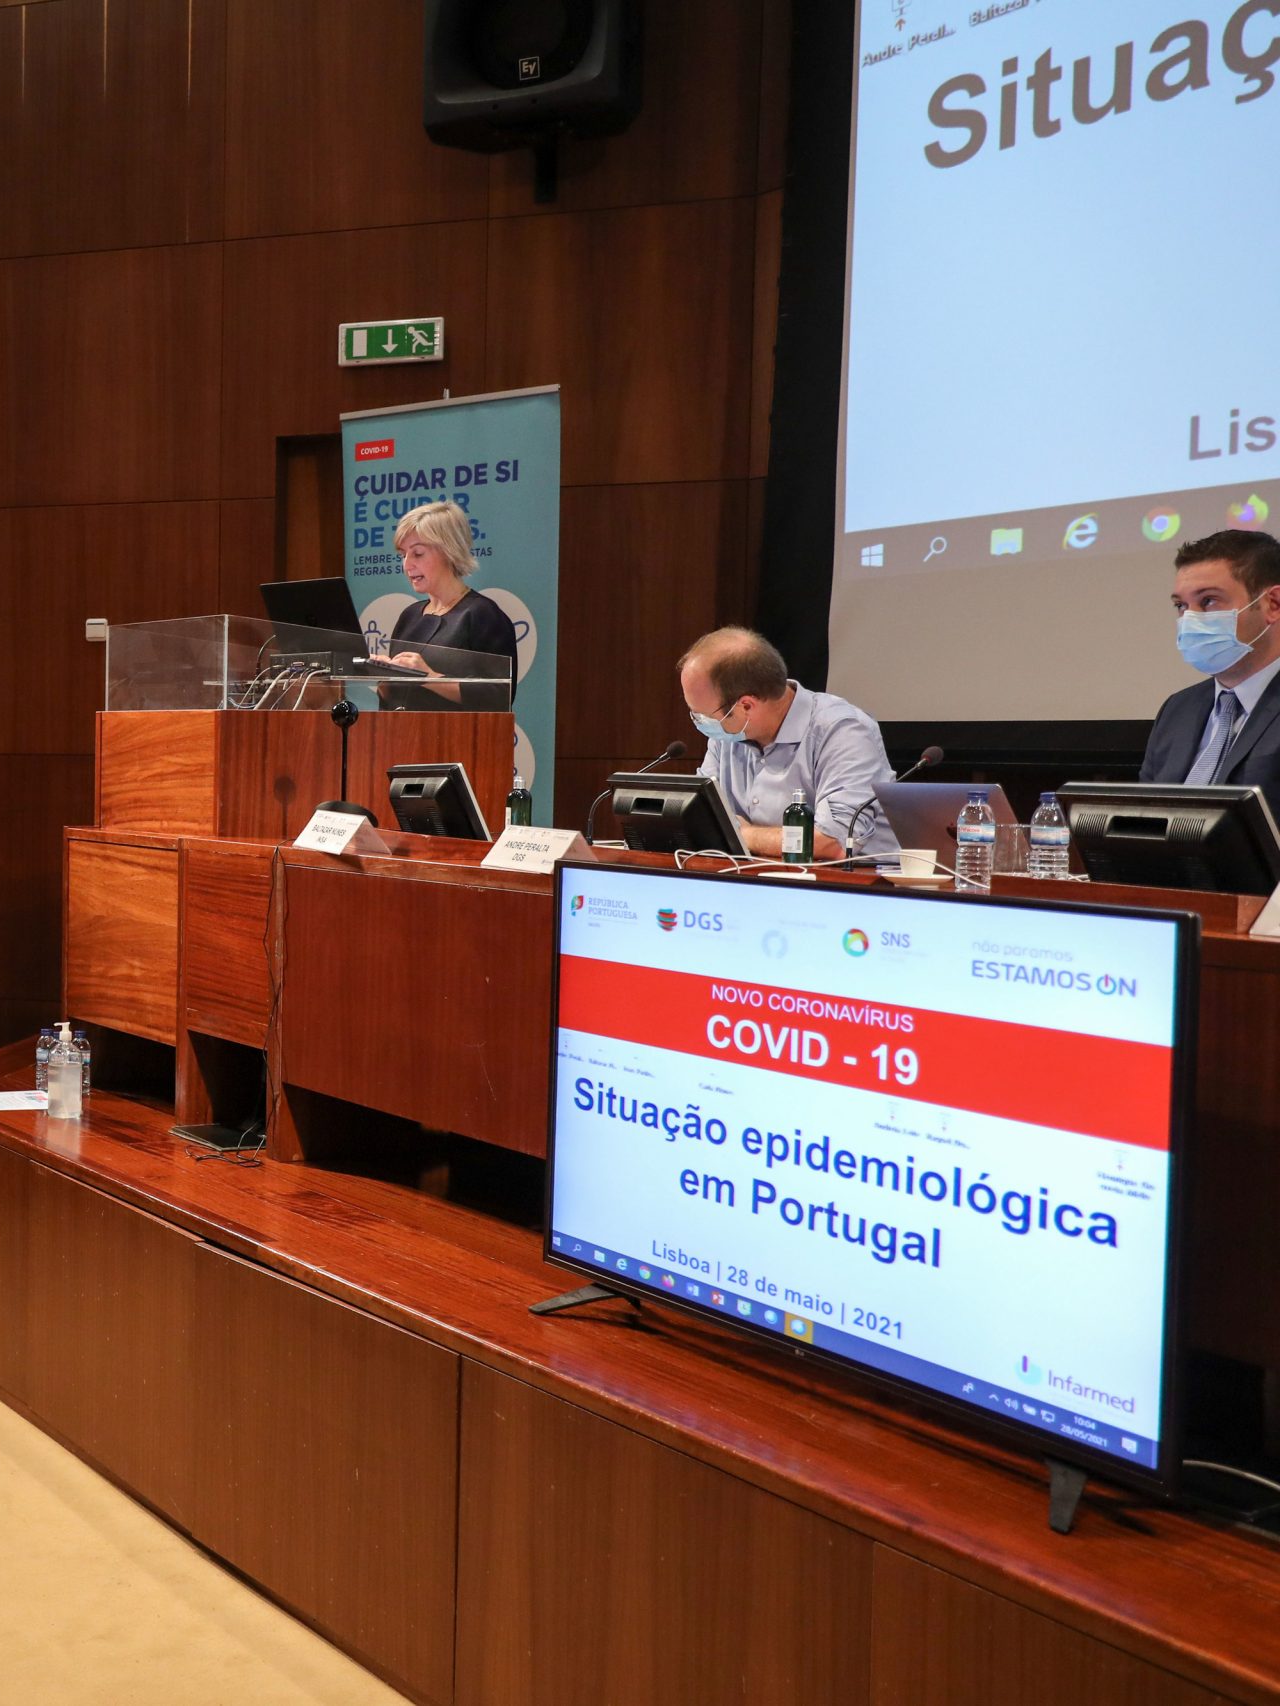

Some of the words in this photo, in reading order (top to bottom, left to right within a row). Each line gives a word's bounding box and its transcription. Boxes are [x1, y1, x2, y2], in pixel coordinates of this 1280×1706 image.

[1189, 409, 1277, 461] Lis
[360, 445, 389, 455] COVID-19
[354, 467, 447, 496] CUIDAR
[454, 462, 488, 487] DE
[495, 459, 519, 483] SI
[354, 496, 368, 523] É
[374, 493, 470, 521] CUIR
[354, 527, 385, 549] DE
[353, 553, 402, 566] LEMBRE-S
[470, 547, 493, 557] STAS
[353, 565, 393, 577] REGRAS
[512, 853, 526, 862] DGS
[524, 842, 550, 853] PERALTA
[588, 906, 638, 920] PORTUGUESA
[683, 910, 723, 932] DGS
[881, 931, 911, 949] SNS
[972, 940, 1000, 954] não
[1003, 944, 1073, 963] paramos
[711, 984, 763, 1007] NOVO
[768, 993, 914, 1033] CORONAVÍRUS
[706, 1014, 829, 1068] COVID
[871, 1043, 919, 1086] 19
[573, 1077, 727, 1145] Situação
[742, 1126, 1119, 1248] epidemiológica
[680, 1168, 735, 1207] em
[751, 1178, 941, 1268] Portugal
[652, 1240, 711, 1274] Lisboa
[727, 1265, 749, 1287] 28
[755, 1275, 778, 1297] de
[784, 1287, 833, 1316] maio
[853, 1307, 903, 1340] 2021
[1048, 1369, 1136, 1414] Infarmed
